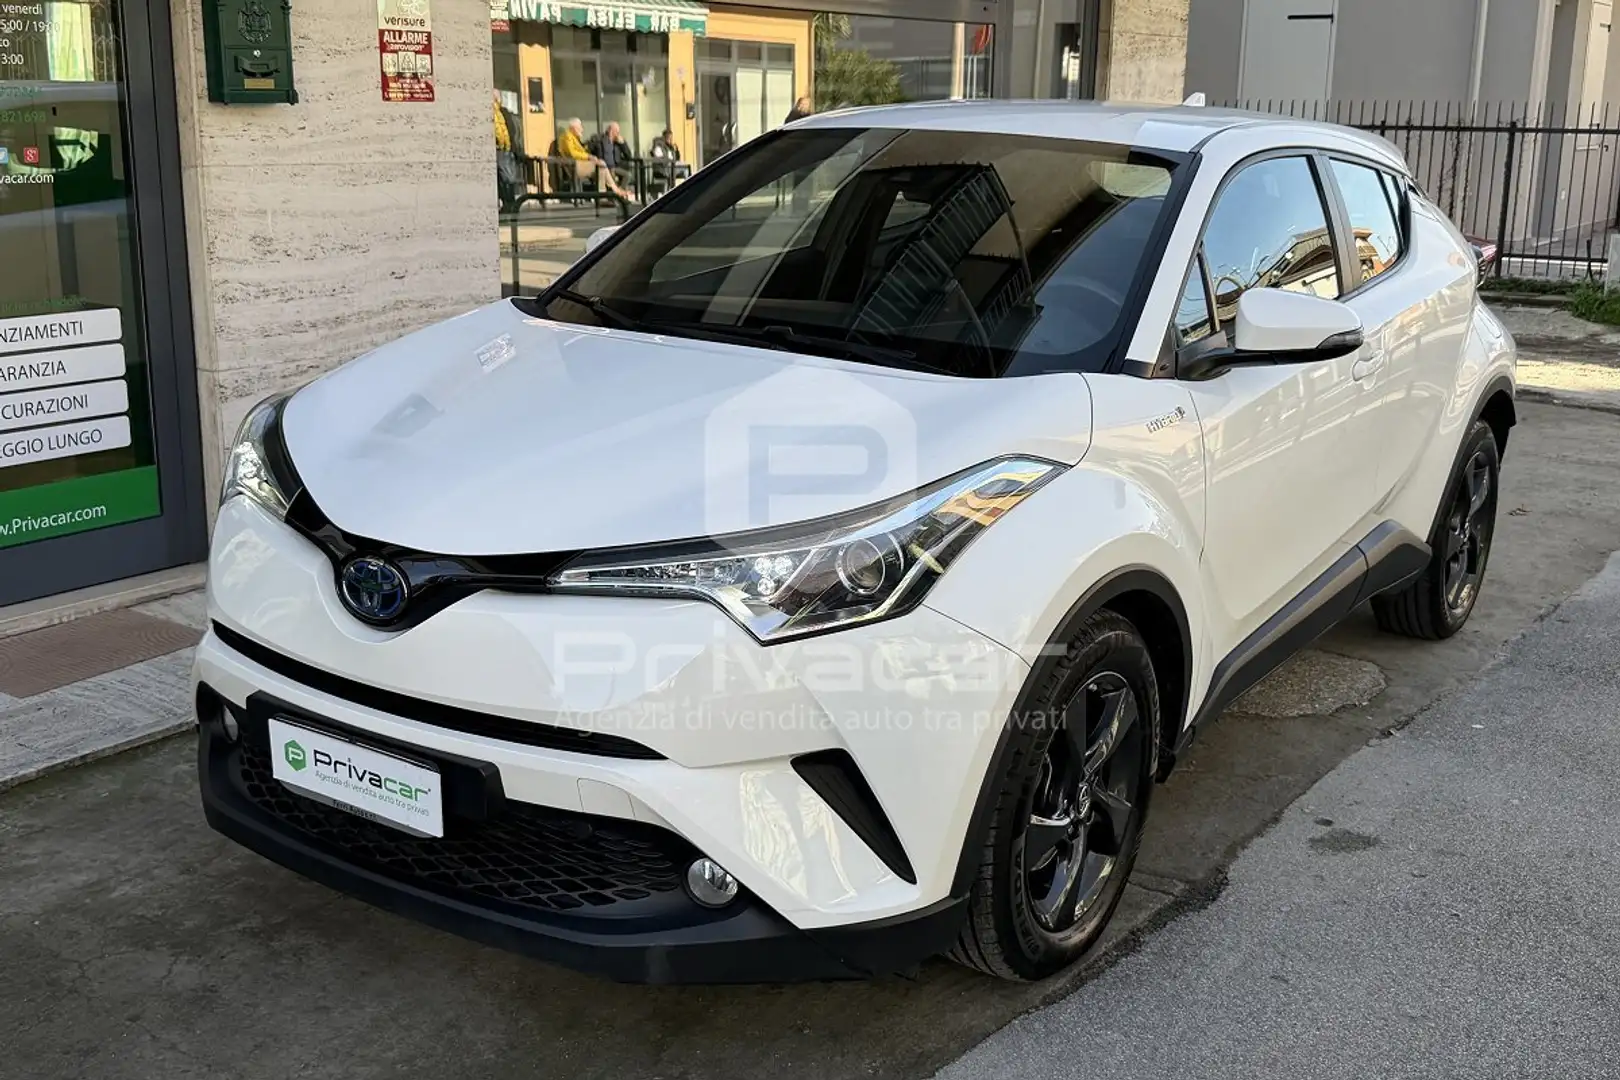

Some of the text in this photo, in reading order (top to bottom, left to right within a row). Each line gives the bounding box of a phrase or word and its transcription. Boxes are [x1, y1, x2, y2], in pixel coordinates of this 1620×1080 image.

[384, 16, 426, 27] verisure
[383, 31, 428, 44] ALLARME
[2, 394, 88, 420] CURAZIONI
[0, 429, 103, 458] GGIO LUNGO
[313, 749, 429, 802] Privacar
